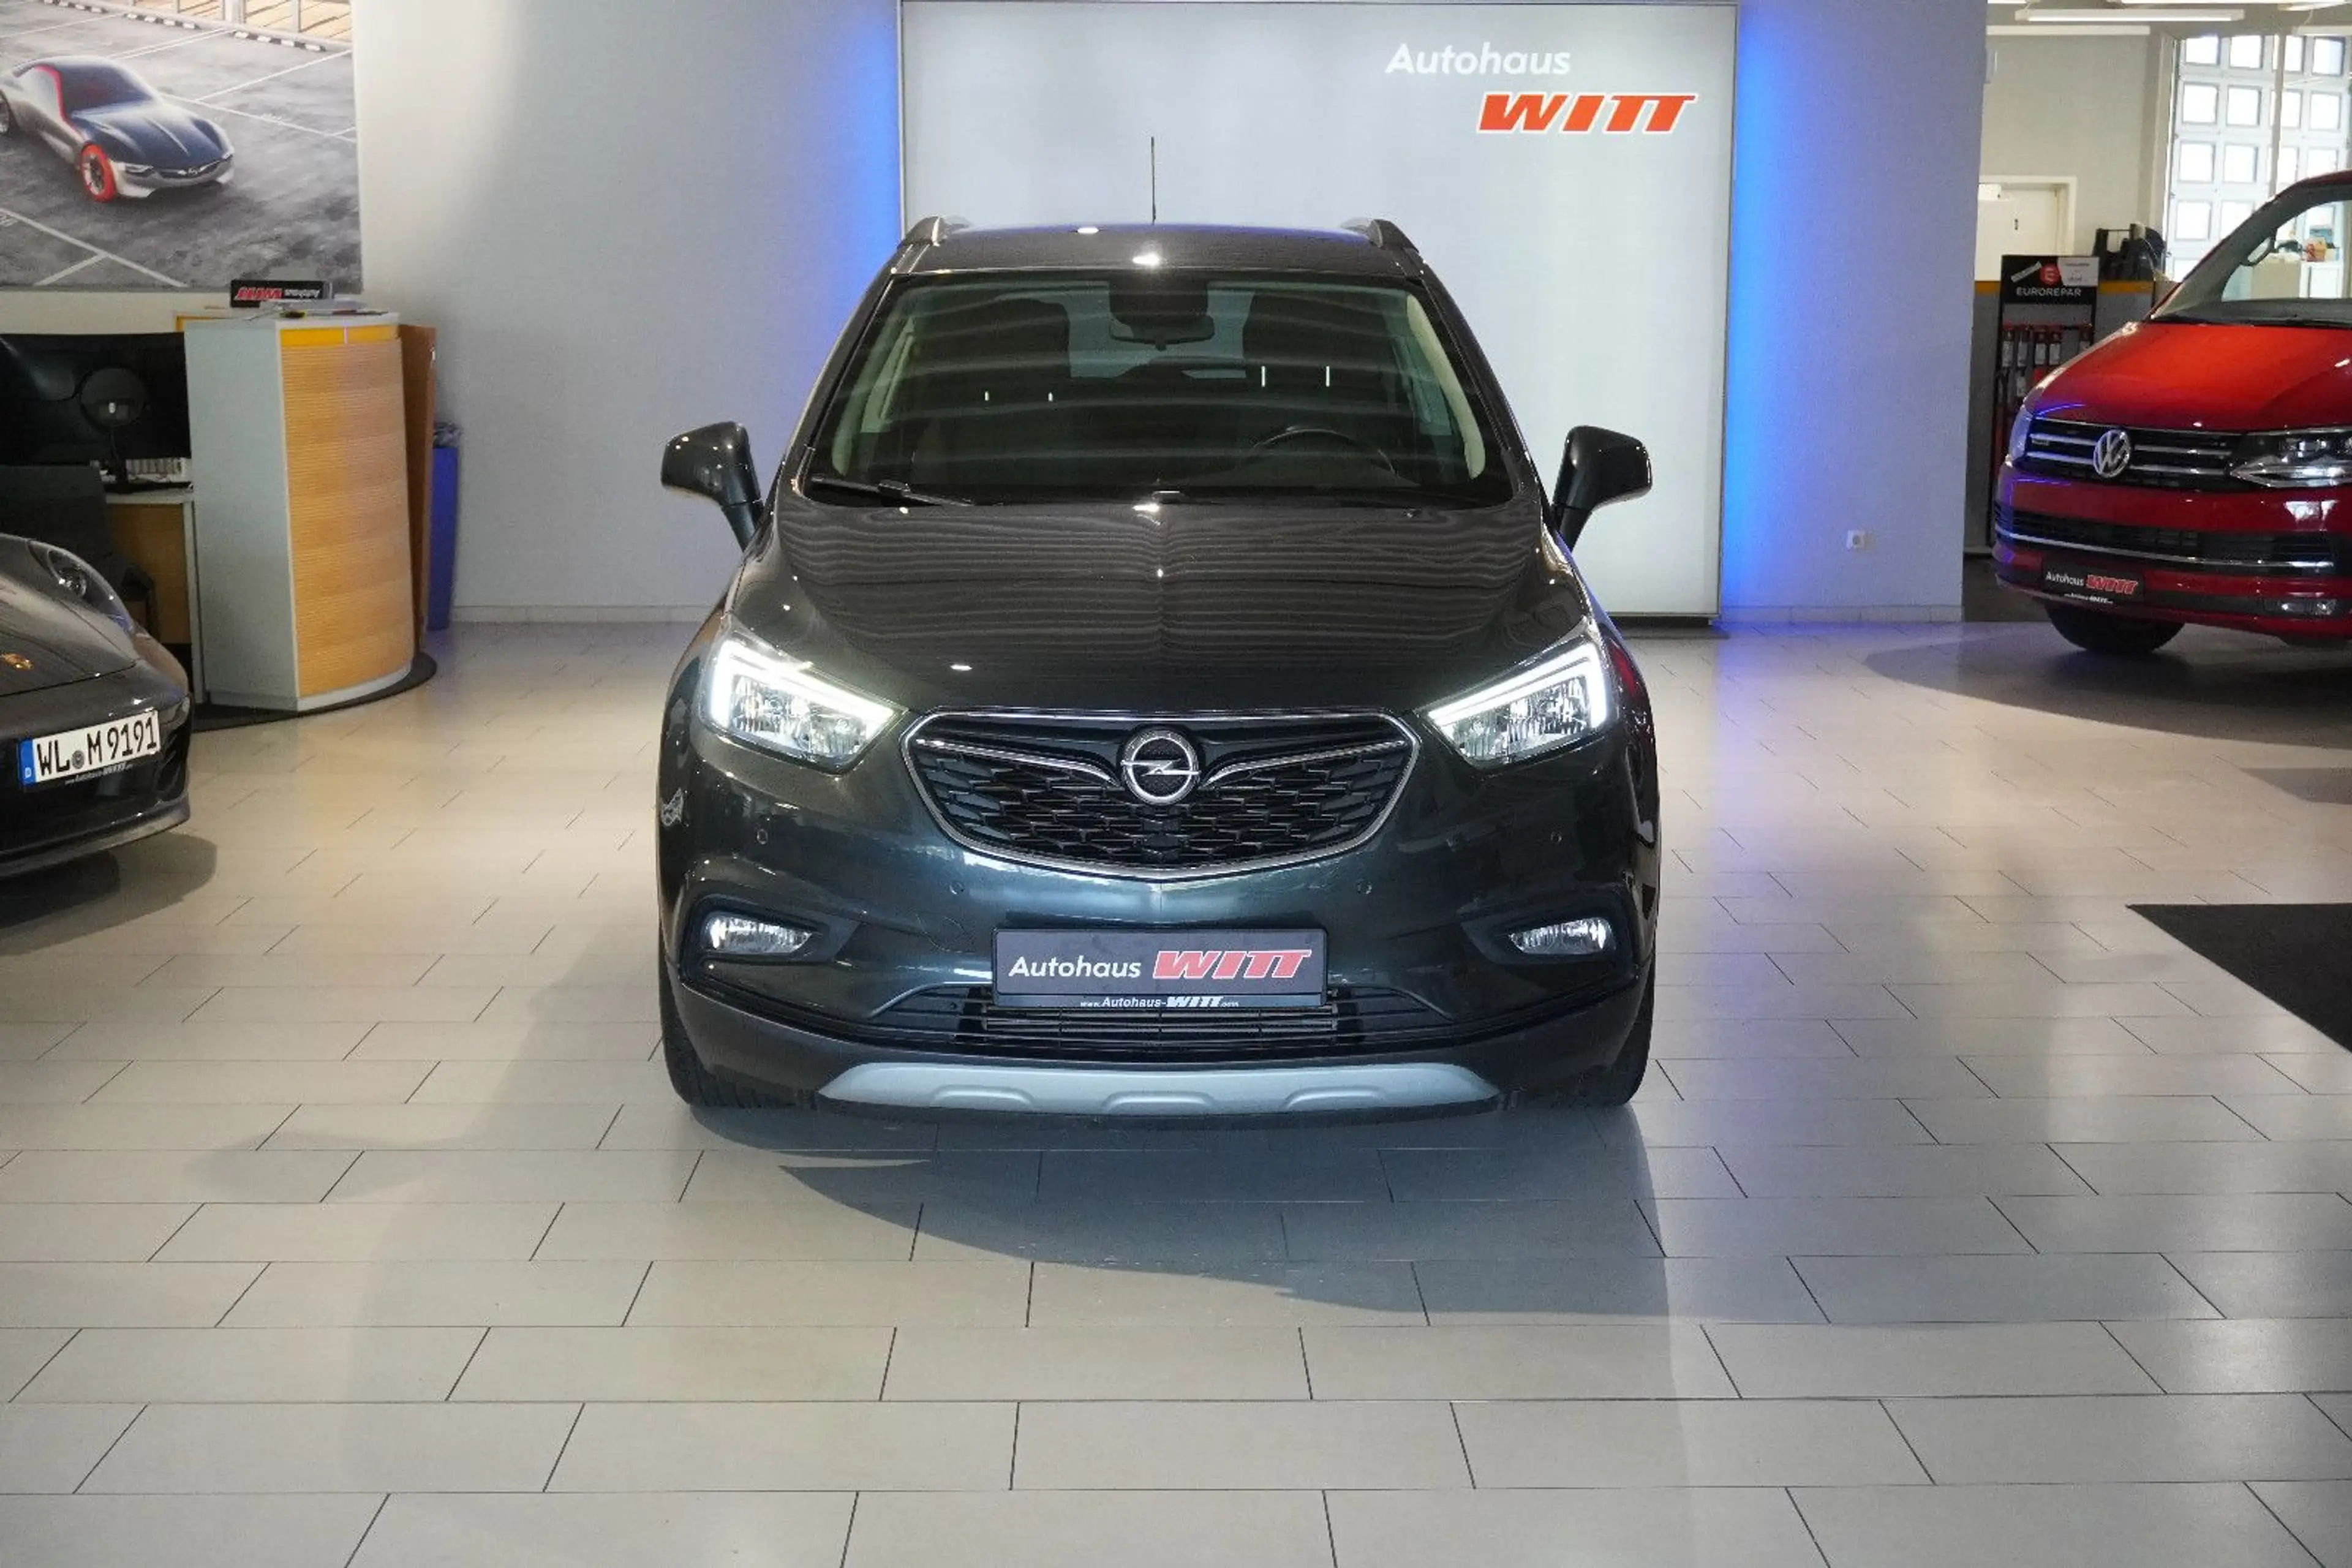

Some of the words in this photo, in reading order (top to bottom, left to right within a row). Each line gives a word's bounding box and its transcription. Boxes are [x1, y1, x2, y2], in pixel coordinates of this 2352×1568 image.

[1385, 41, 1571, 75] Autohaus
[1477, 91, 1700, 134] WITT
[2016, 286, 2082, 297] EUROREPAR
[2045, 571, 2084, 586] Autohaus
[2086, 575, 2138, 594] WITT
[37, 739, 70, 777] WL
[1008, 955, 1141, 978] Autohaus
[1152, 949, 1312, 980] WITT
